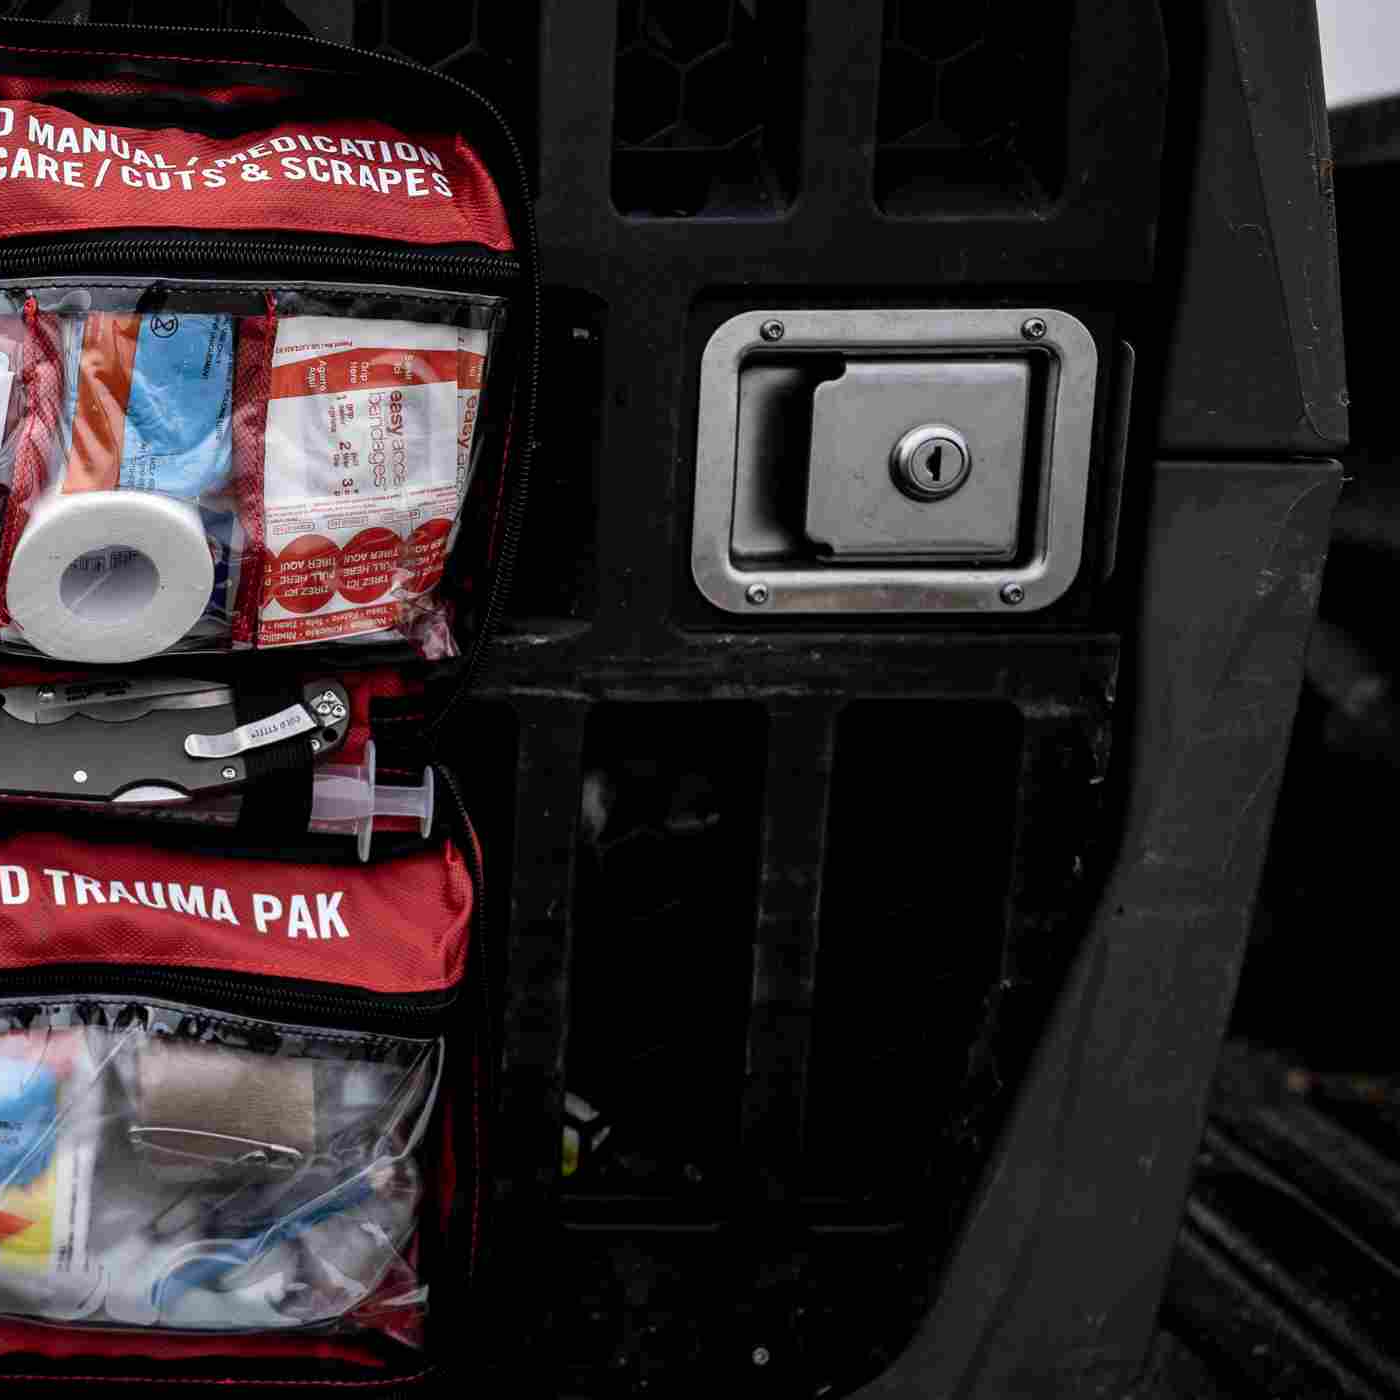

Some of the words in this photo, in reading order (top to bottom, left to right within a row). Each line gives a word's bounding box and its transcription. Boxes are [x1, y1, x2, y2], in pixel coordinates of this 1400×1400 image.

[29, 115, 177, 169] MANUAL
[214, 134, 443, 171] MEDICATION
[121, 166, 227, 191] CUTS
[241, 164, 273, 183] &
[281, 156, 453, 198] SCRAPES
[386, 390, 403, 436] easy
[339, 440, 352, 451] 2
[368, 391, 386, 489] bandages
[342, 478, 353, 487] 3
[44, 868, 241, 926] TRAUMA
[253, 892, 350, 940] PAK
